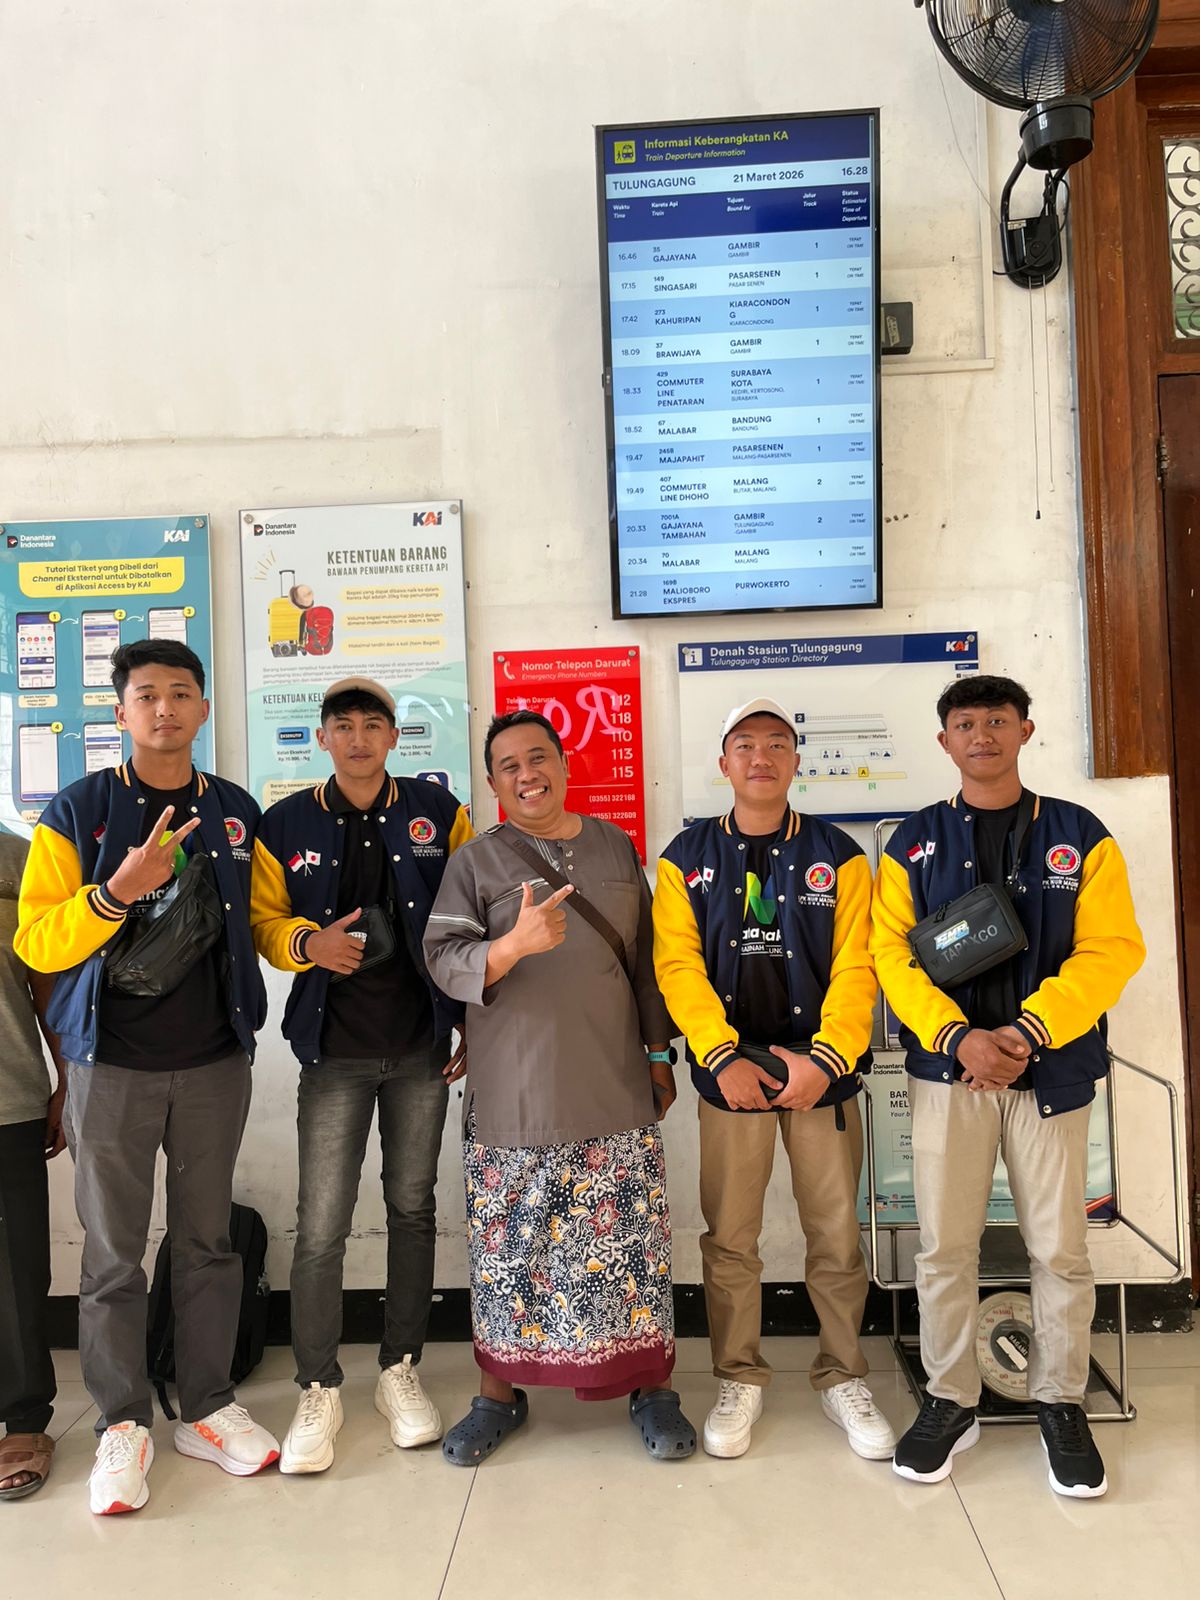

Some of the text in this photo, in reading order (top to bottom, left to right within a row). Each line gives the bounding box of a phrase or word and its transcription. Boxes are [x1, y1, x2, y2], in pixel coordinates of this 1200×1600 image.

[644, 131, 789, 149] Informasi Keberangkatan KA
[645, 148, 746, 162] Train Departure Information
[842, 166, 868, 176] 16.28
[733, 170, 804, 183] 21 Maret 2026
[613, 177, 696, 190] TULUNGAGUNG
[728, 242, 760, 250] GAMBIR
[653, 253, 696, 262] GAJAYANA
[729, 270, 780, 280] PASARSENEN
[654, 283, 697, 292] SINGASARI
[729, 298, 790, 308] KIARACONDON
[655, 316, 701, 325] KAHURIPAN
[730, 338, 762, 347] GAMBIR
[656, 349, 701, 358] BRAWIJAYA
[731, 368, 772, 377] SURABAYA
[657, 378, 704, 387] COMMUTER
[657, 398, 704, 407] PENATARAN
[732, 416, 772, 424] BANDUNG
[658, 427, 697, 435] MALABAR
[733, 443, 784, 452] PASARSENEN
[659, 455, 705, 464] MAJAPAHIT
[733, 478, 768, 486] MALANG
[660, 483, 707, 492] COMMUTER
[680, 493, 709, 501] DHOHO
[413, 511, 442, 527] KAI
[661, 521, 703, 530] GAJAYANA
[164, 530, 190, 543] KAI
[661, 531, 706, 540] TAMBAHAN
[328, 546, 448, 565] KETENTUAN BARANG
[98, 565, 118, 574] yang
[120, 563, 141, 571] Dibeli
[143, 562, 158, 570] dari
[662, 559, 700, 567] MALABAR
[327, 563, 448, 576] BAWAAN PENUMPANG KERETA API
[32, 571, 172, 583] Channel Eksternal untuk Dibatalkan
[65, 582, 96, 592] Aplikasi
[127, 582, 136, 591] by
[735, 580, 790, 589] PURWOKERTO
[663, 586, 710, 595] MALIOBORO
[664, 597, 696, 605] EKSPRES
[710, 642, 862, 657] Denah Stasiun Tulungagung
[946, 641, 969, 652] KAI
[522, 658, 631, 671] Nomor Telepon Darurat
[711, 654, 828, 666] Tulungagung Station Directory
[263, 694, 305, 704] KETENTUAN
[610, 694, 631, 707] 112
[610, 712, 632, 724] 118
[611, 730, 632, 743] 110
[612, 748, 634, 760] 113
[612, 766, 634, 778] 115
[193, 1422, 223, 1450] HOKA
